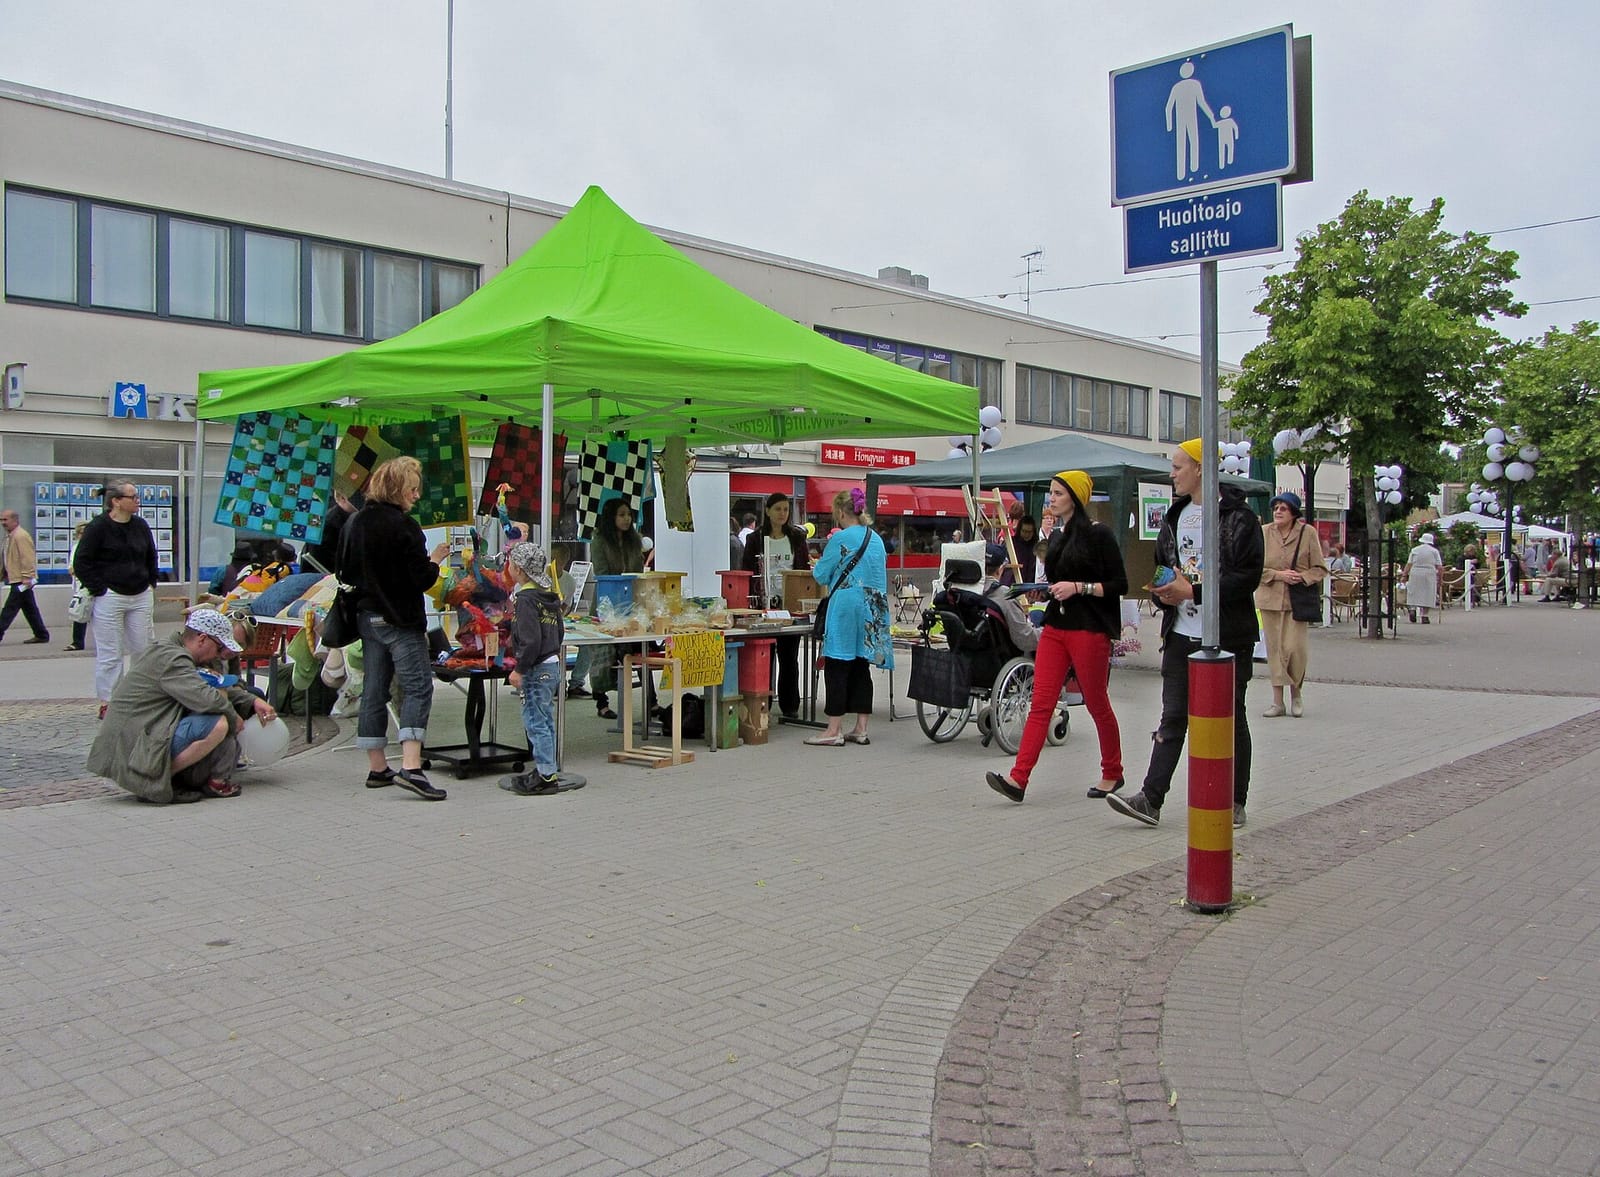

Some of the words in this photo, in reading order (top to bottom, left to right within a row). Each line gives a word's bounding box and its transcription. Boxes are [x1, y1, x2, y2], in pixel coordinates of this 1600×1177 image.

[1159, 198, 1242, 229] Huoltoajo
[1170, 229, 1230, 254] sallittu
[854, 450, 885, 466] Hongyun
